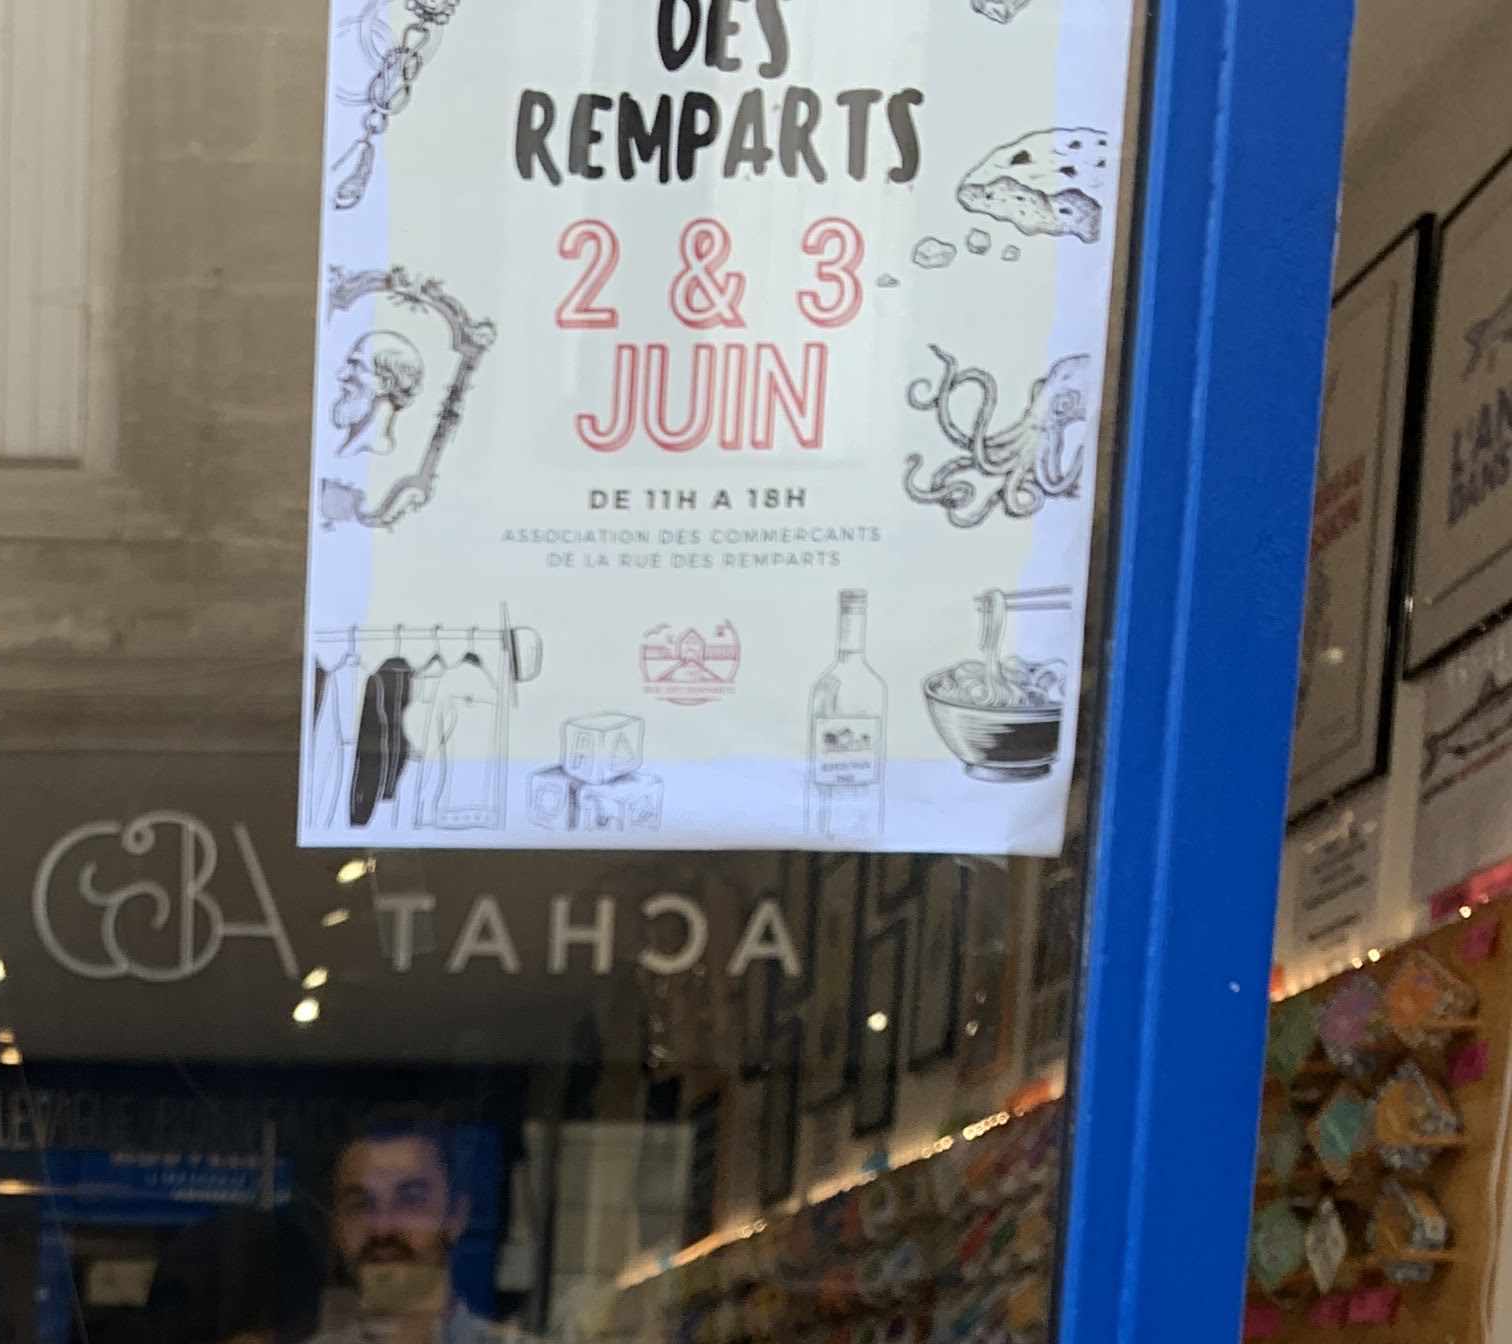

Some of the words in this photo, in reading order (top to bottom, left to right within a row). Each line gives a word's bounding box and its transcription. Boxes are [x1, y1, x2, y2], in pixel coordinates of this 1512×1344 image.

[656, 0, 791, 79] DES
[513, 88, 925, 187] REMPARTS
[556, 218, 621, 329] 2
[670, 216, 747, 329] &
[797, 216, 865, 327] 3
[576, 341, 829, 452] JUIN
[501, 528, 649, 545] ASSOCIATION
[660, 528, 701, 544] DES
[590, 490, 631, 510] DE
[644, 489, 697, 510] 11H
[713, 489, 733, 509] A
[747, 487, 807, 509] 18H
[546, 552, 575, 568] DE
[588, 552, 609, 568] LA
[619, 552, 662, 568] RUE
[670, 552, 713, 568] DES
[722, 551, 841, 568] REMPARTS
